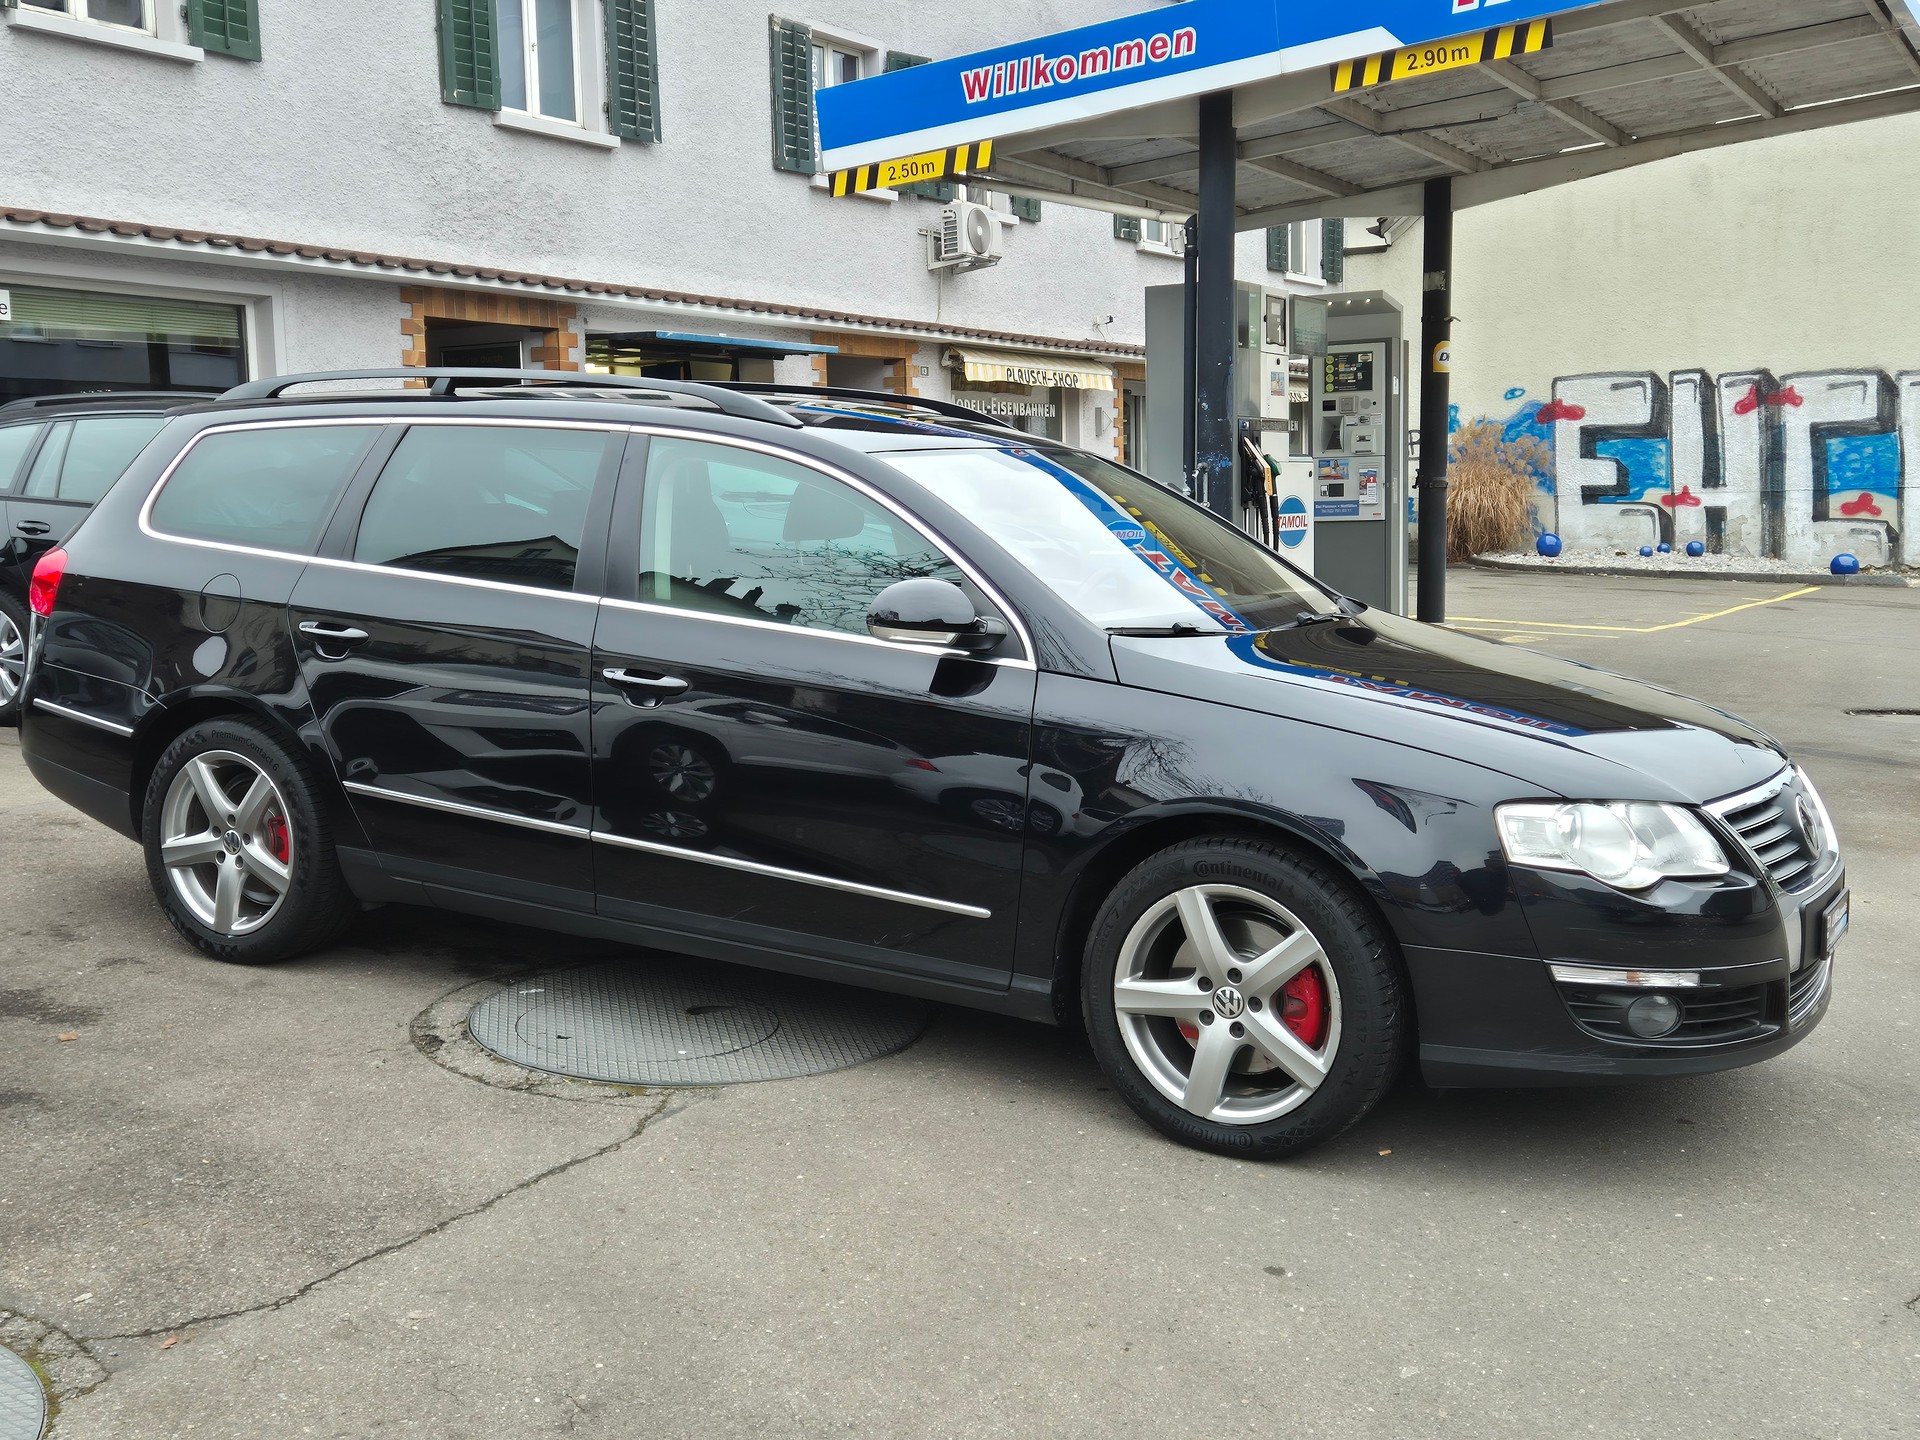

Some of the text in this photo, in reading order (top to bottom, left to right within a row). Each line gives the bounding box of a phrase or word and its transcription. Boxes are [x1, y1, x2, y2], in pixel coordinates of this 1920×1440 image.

[961, 26, 1196, 104] Willkommen
[1406, 46, 1469, 70] 2.90 m
[887, 161, 935, 181] 2.50 m
[1193, 860, 1285, 891] Continental
